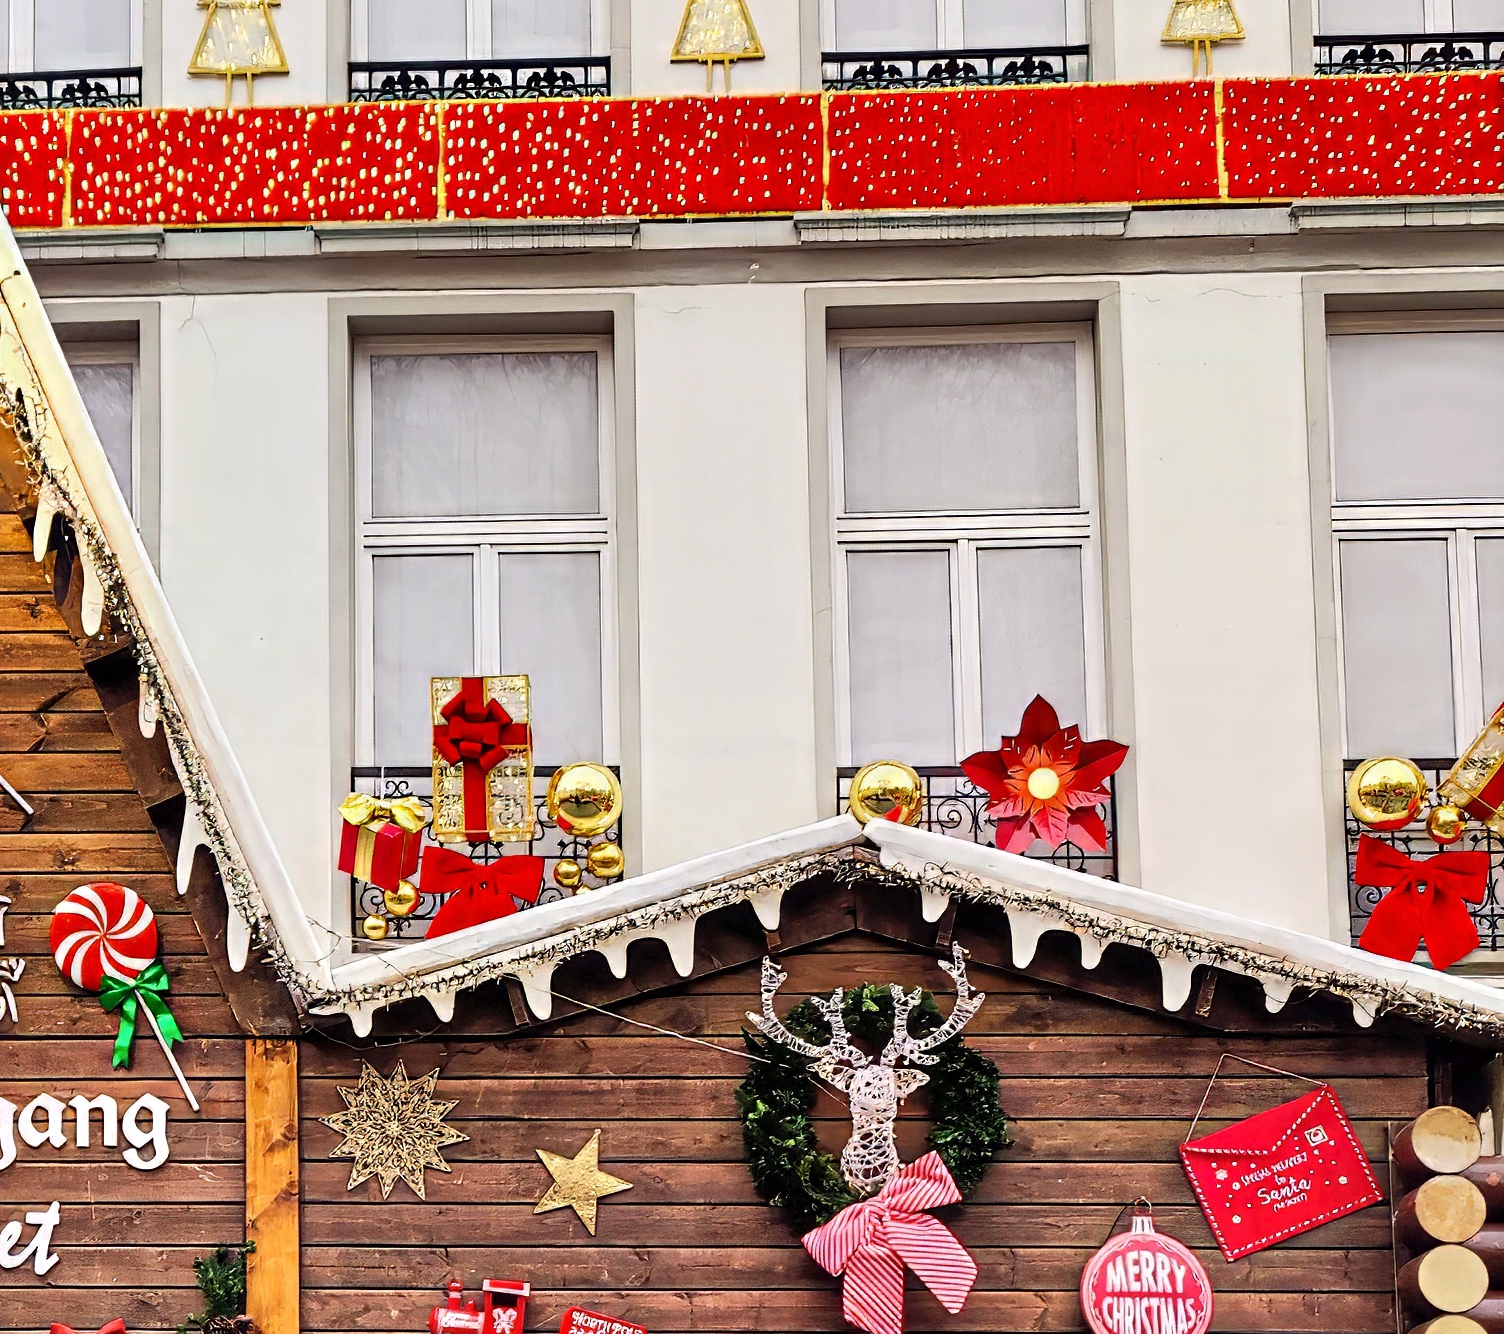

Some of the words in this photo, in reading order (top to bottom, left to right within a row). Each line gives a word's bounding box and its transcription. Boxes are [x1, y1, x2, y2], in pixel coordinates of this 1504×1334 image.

[1257, 1176, 1311, 1205] Santa
[1106, 1251, 1187, 1294] MERRY
[571, 1310, 610, 1334] NORTH
